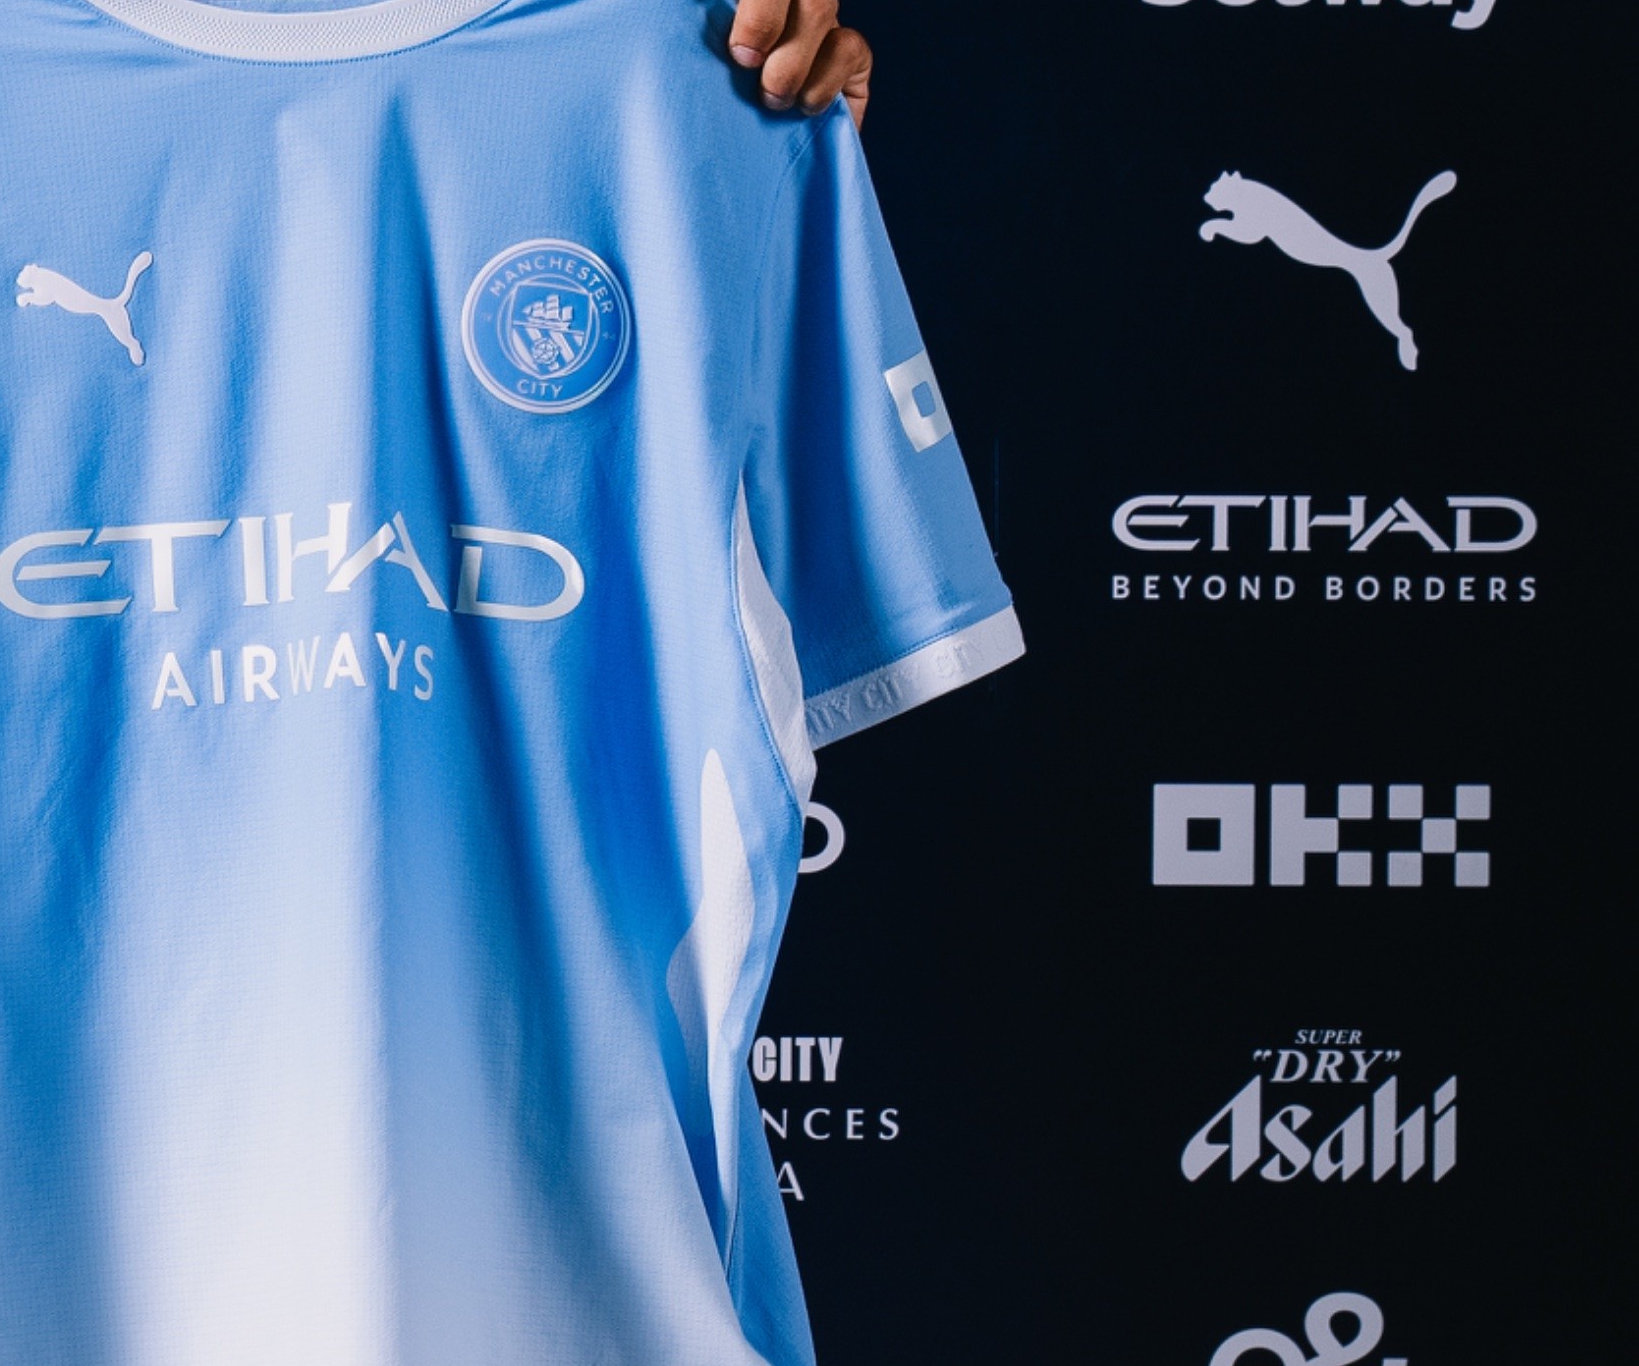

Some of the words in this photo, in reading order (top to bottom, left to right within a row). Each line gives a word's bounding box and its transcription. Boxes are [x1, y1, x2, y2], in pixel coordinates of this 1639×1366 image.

[489, 255, 615, 315] MANCHESTER
[517, 378, 564, 399] CITY
[1112, 495, 1537, 552] ETIHAD
[1112, 575, 1295, 600] BEYOND
[1326, 576, 1535, 602] BORDERS
[151, 631, 435, 711] AIRWAYS
[1153, 784, 1490, 887] OKX
[752, 1036, 843, 1082] CITY
[1296, 1030, 1362, 1044] SUPER
[1181, 1075, 1456, 1182] Asahi
